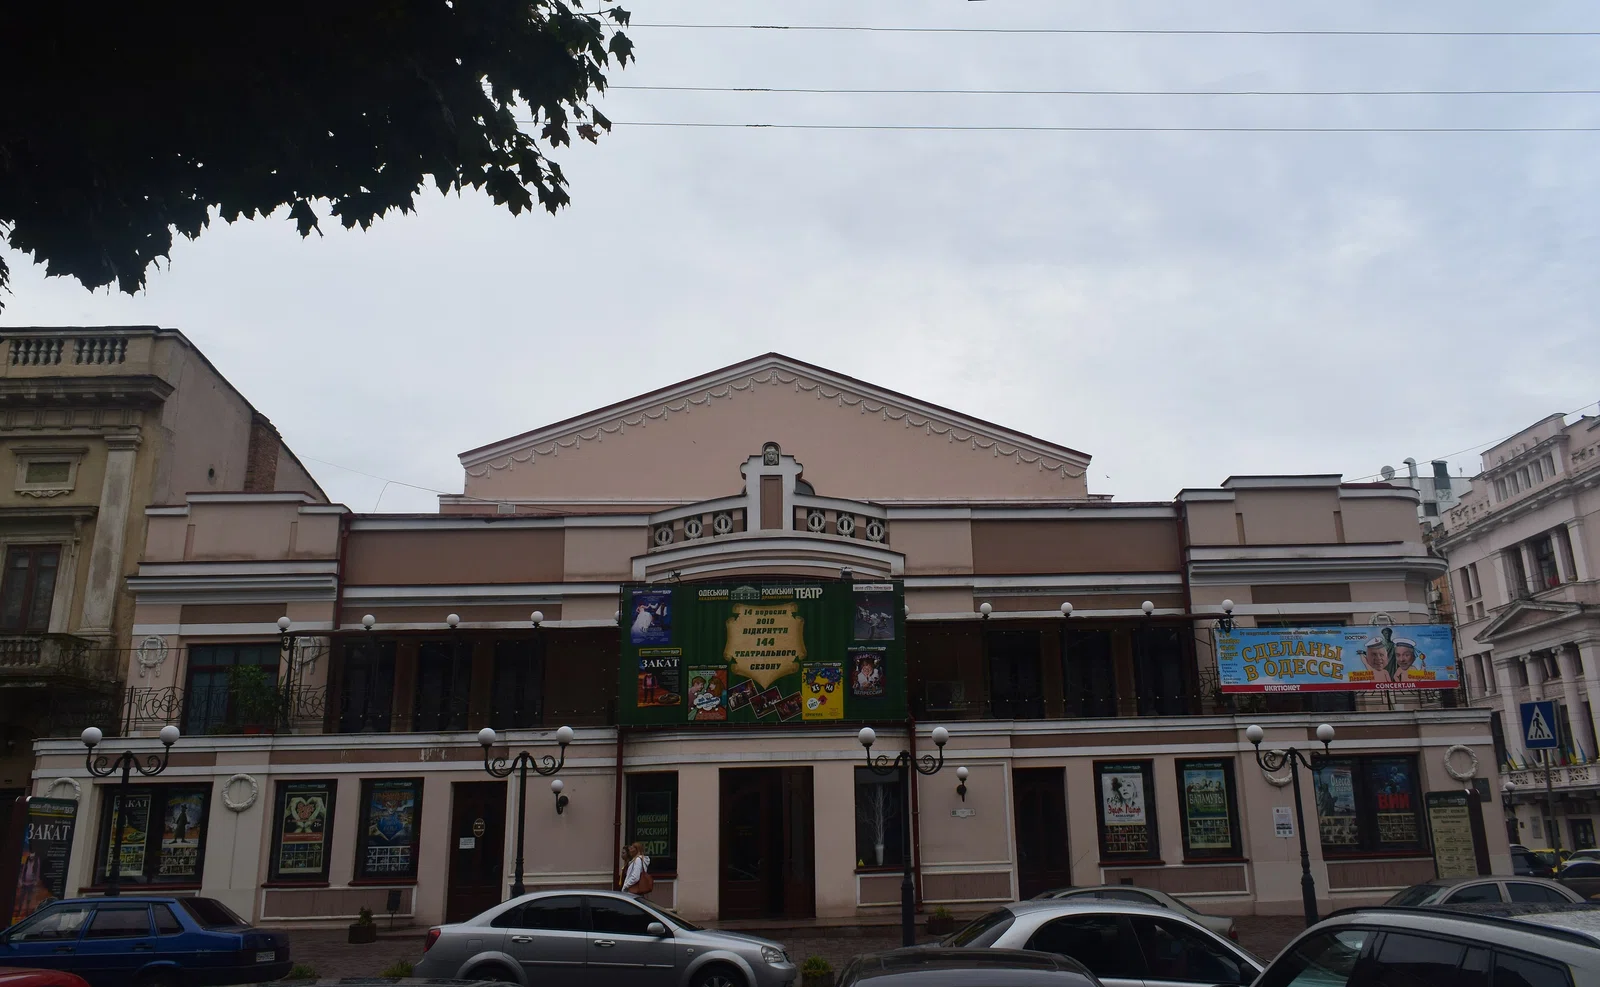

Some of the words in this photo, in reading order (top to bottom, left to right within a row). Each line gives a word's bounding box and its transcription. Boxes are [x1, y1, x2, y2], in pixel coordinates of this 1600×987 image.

[698, 588, 729, 597] ОДЕСЬКИЙ
[794, 587, 824, 600] ТЕАТР
[744, 608, 753, 616] 14
[743, 627, 789, 636] ВІДКРИТТЯ
[756, 637, 775, 646] 144
[735, 649, 797, 658] ТЕАТРАЛЬНОГО
[1242, 641, 1343, 664] СДЕЛАНЫ
[642, 658, 680, 668] ЗАКАТ
[749, 663, 782, 671] СЕЗОНУ
[1243, 664, 1260, 682] В
[1264, 659, 1345, 680] ОДЕССЕ
[1375, 682, 1417, 690] CONCERT.UA
[27, 822, 71, 842] ЗАКАТ
[636, 827, 668, 837] РУССКИЙ
